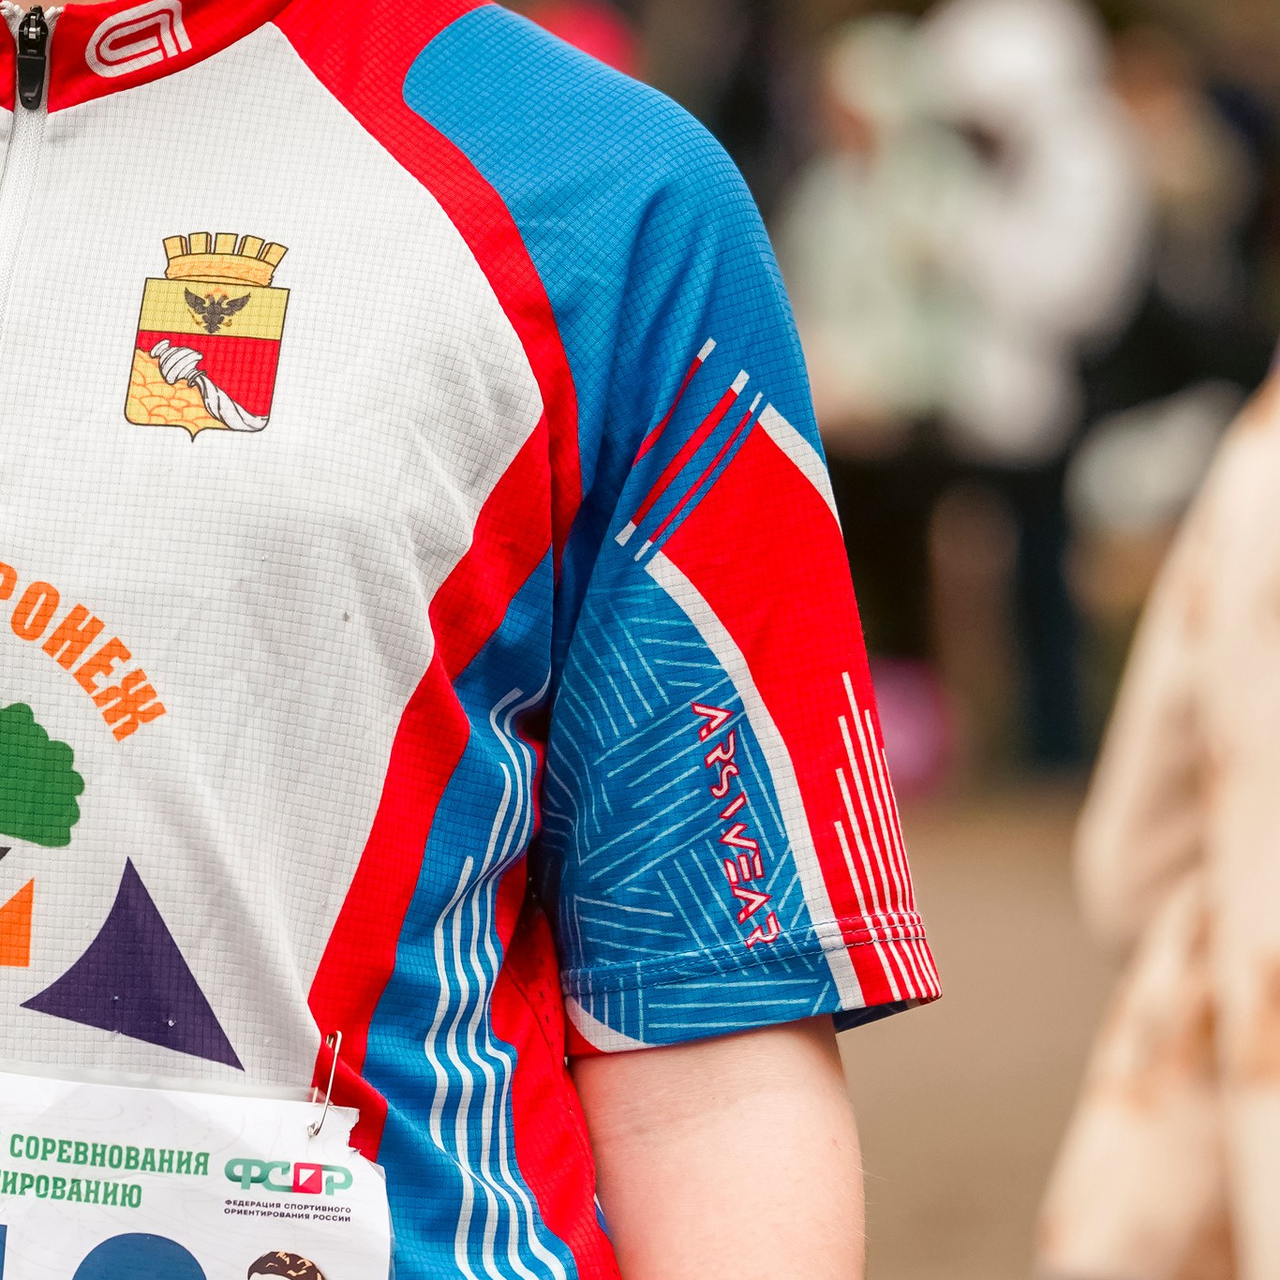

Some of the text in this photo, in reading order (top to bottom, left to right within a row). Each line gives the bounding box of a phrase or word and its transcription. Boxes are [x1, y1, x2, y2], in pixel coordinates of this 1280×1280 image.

[690, 701, 781, 949] ARSWEAR
[9, 1133, 211, 1177] СОРЕВНОВАНИЯ
[224, 1199, 352, 1214] ФЕДЕРАЦИЯ СПОРТИВНОГО
[224, 1207, 351, 1222] ОРИЕНТИРОВАНИЯ РОССИИ
